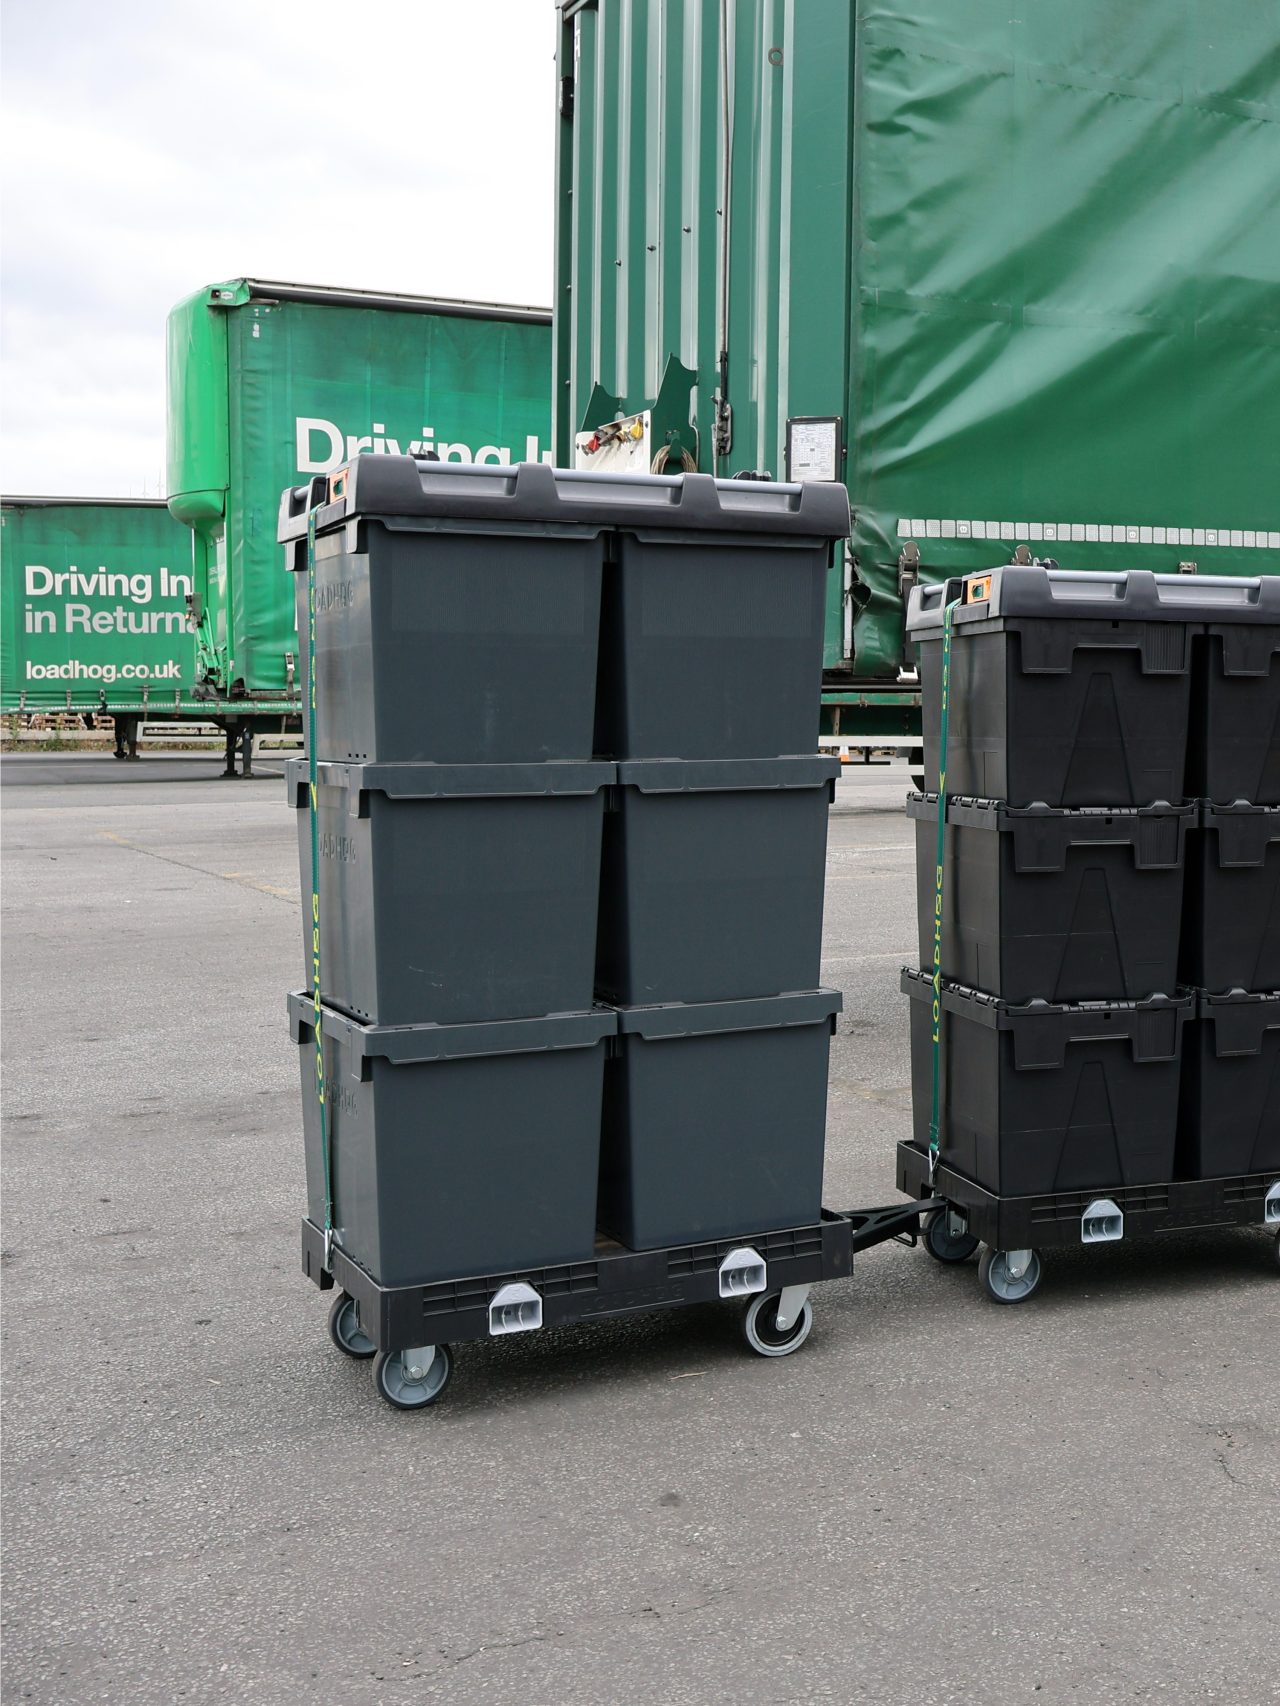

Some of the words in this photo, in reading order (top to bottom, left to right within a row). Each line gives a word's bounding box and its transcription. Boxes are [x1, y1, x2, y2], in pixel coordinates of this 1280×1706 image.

[527, 435, 552, 466] I
[25, 565, 152, 604] Driving
[160, 567, 194, 597] In
[25, 603, 57, 634] in
[26, 660, 182, 684] loadhog.co.uk
[932, 865, 943, 1042] LOADHOG
